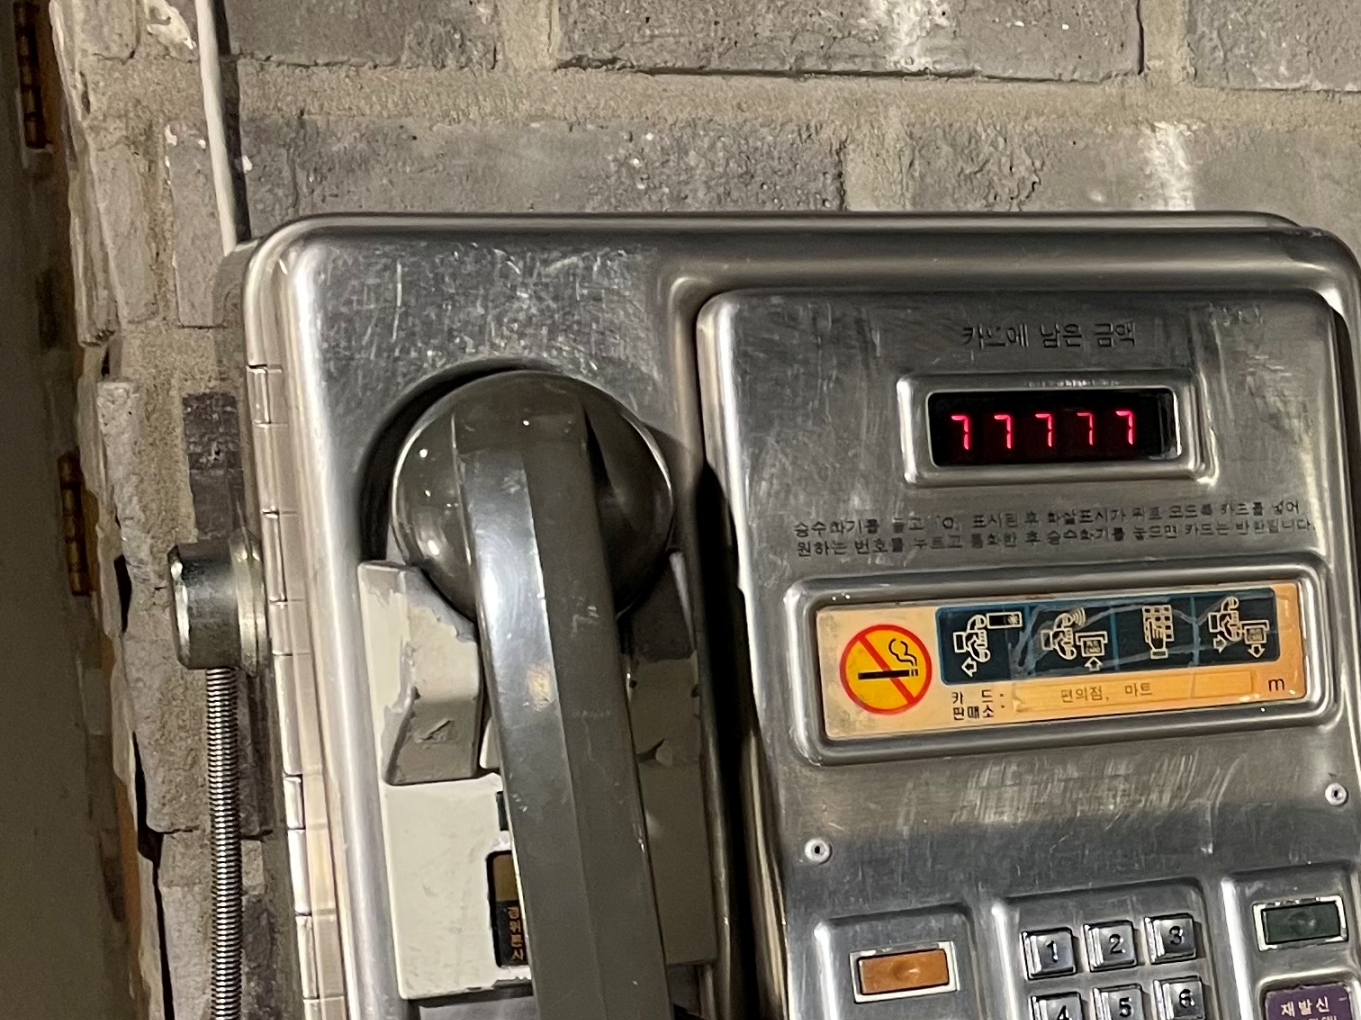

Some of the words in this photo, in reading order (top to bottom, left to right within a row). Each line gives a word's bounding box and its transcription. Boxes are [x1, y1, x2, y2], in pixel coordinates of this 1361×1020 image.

[961, 322, 1029, 349] 카드에
[1040, 321, 1083, 349] 남은
[1093, 321, 1136, 348] 금액
[796, 539, 848, 558] 원하는
[1185, 520, 1230, 537] 카드는
[1124, 682, 1153, 698] 마트
[1268, 678, 1286, 692] m
[952, 705, 994, 721] 판매소
[1045, 939, 1060, 963] 1
[1109, 933, 1126, 955] 2
[1168, 925, 1184, 946] 3
[1118, 996, 1133, 1018] 5
[1178, 988, 1195, 1009] 6
[1280, 996, 1330, 1017] 재발신
